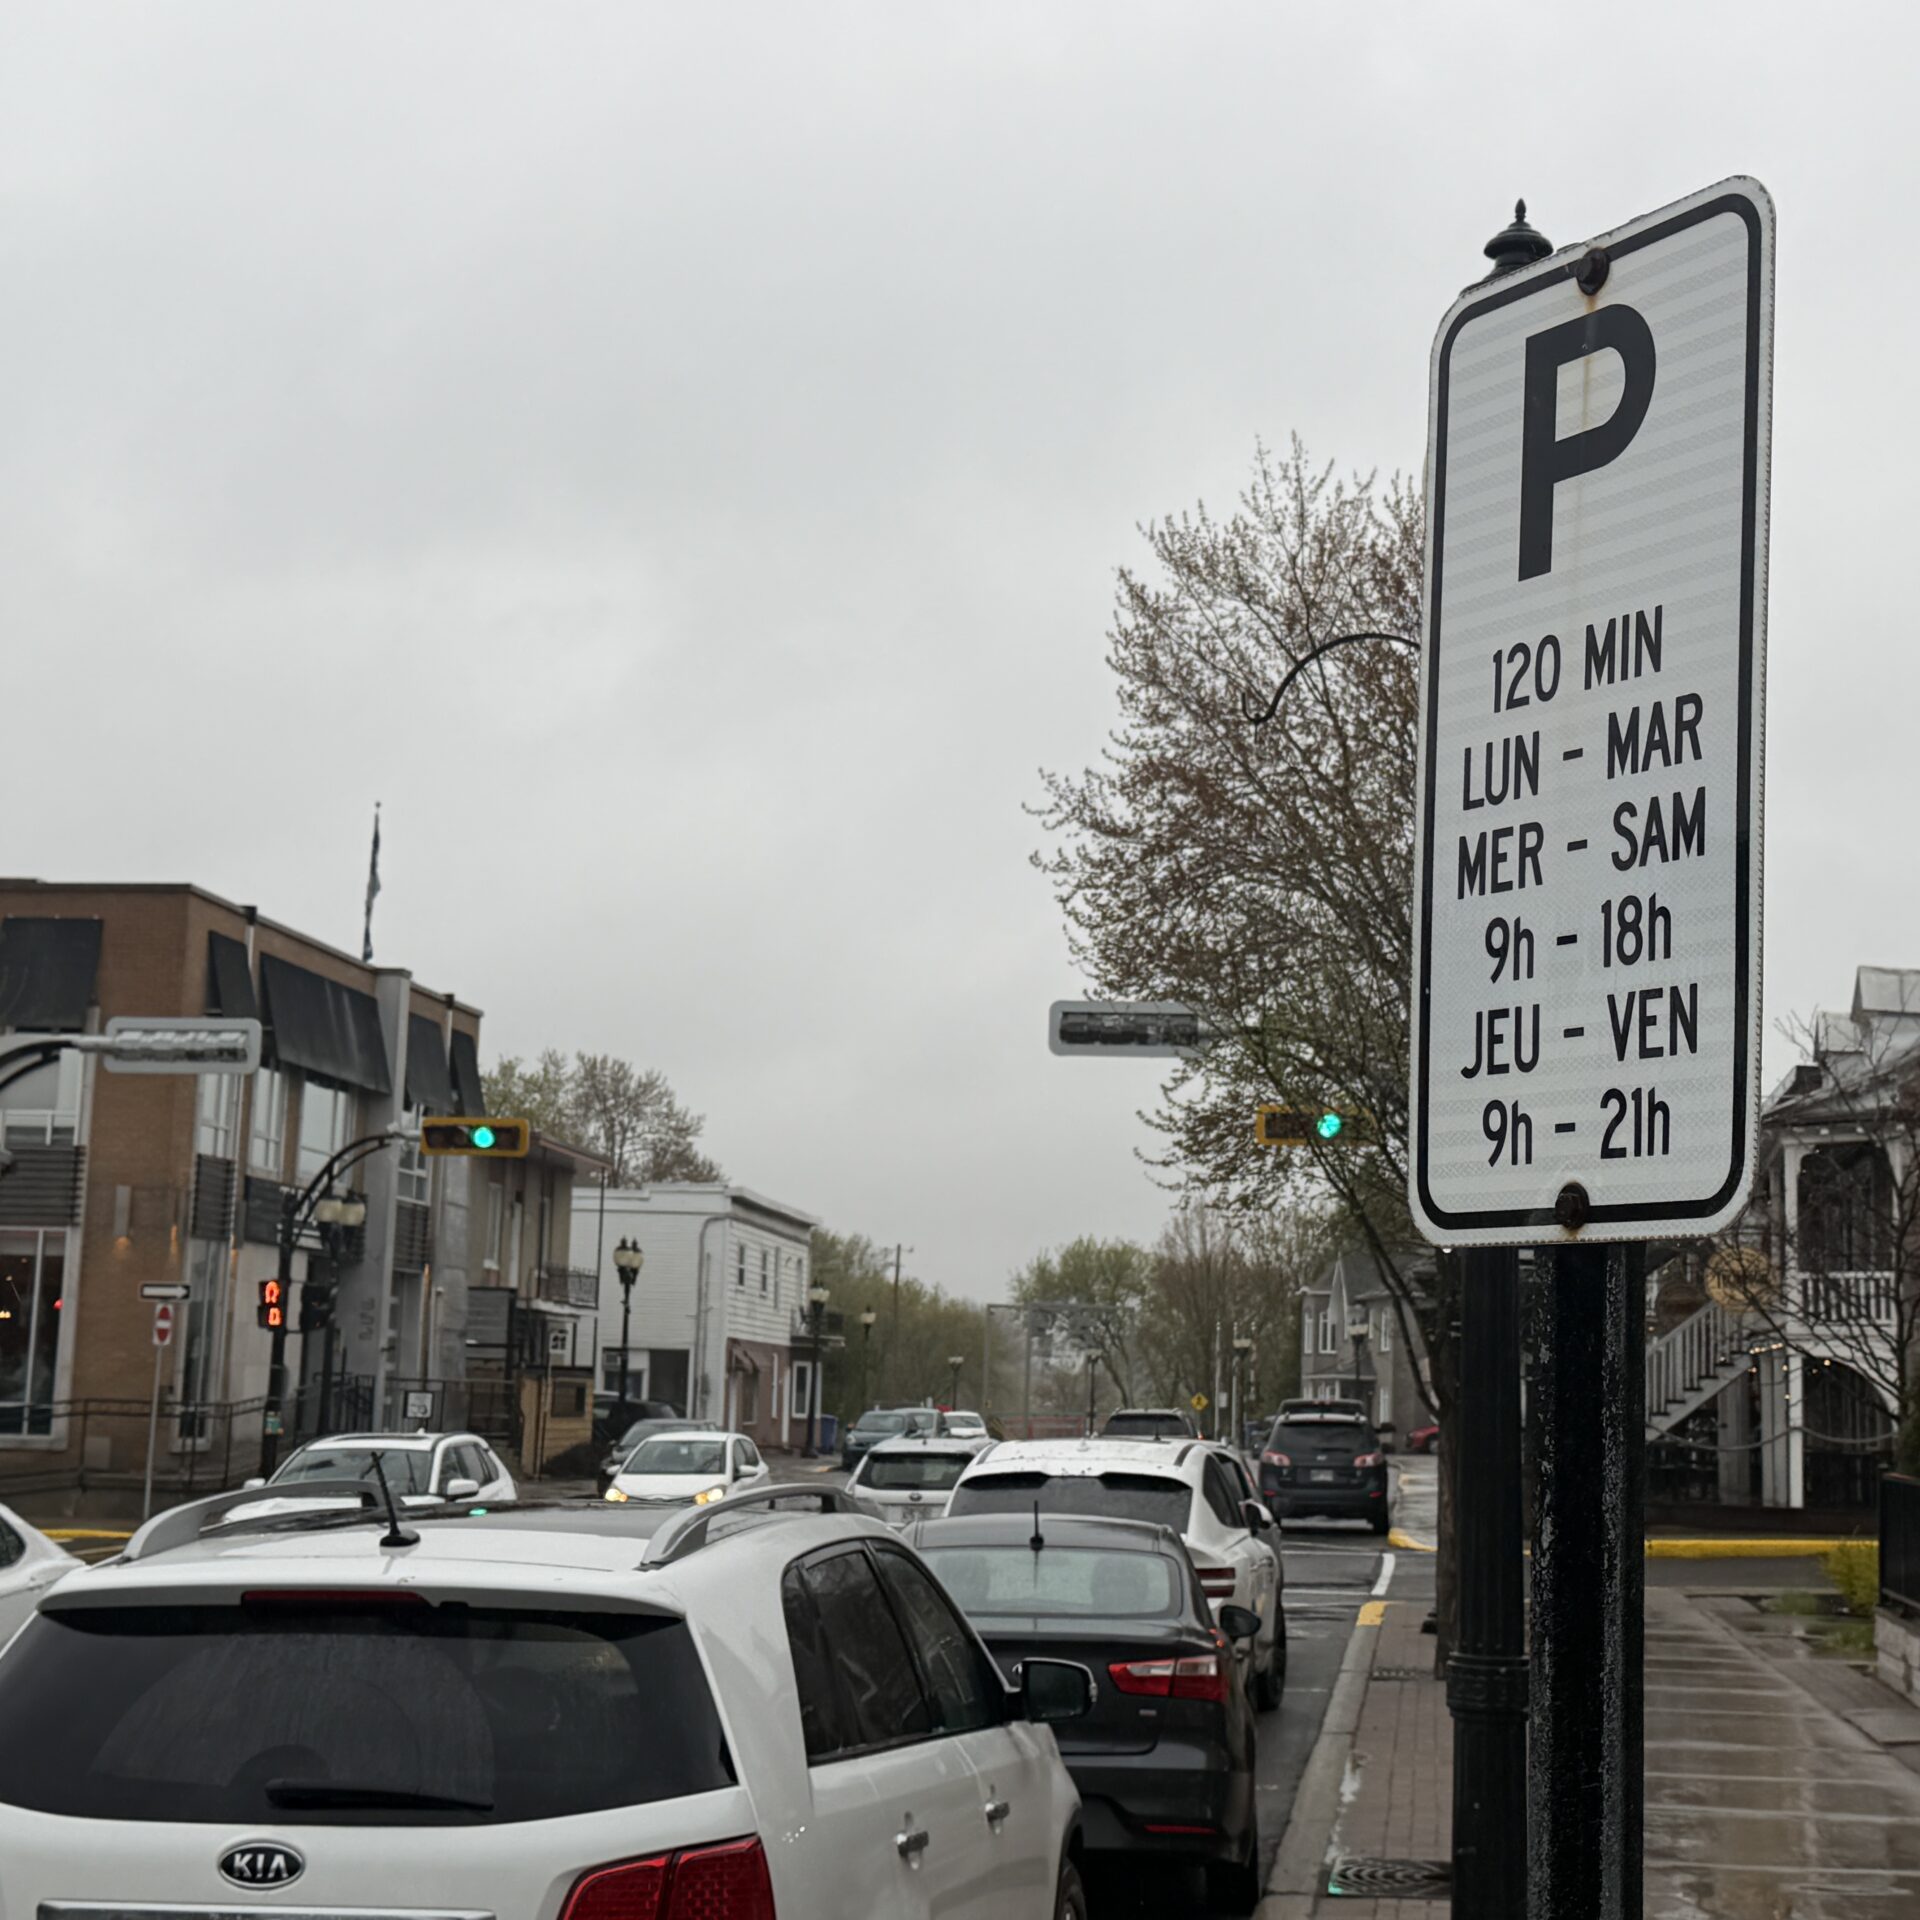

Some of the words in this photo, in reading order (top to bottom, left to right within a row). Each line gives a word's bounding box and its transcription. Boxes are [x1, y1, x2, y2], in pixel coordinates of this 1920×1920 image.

[1517, 303, 1657, 583] P
[1492, 634, 1561, 714] 120
[1584, 604, 1663, 691] MIN
[1462, 730, 1540, 812] LUN
[1562, 747, 1584, 762] -
[1607, 692, 1704, 780] MAR
[1457, 821, 1545, 901] MER
[1566, 838, 1588, 853] -
[1610, 785, 1706, 872] SAM
[1484, 915, 1535, 985] 9h
[1556, 933, 1578, 947] -
[1600, 892, 1672, 968] 18h
[1460, 1003, 1540, 1080] JEU
[1563, 1026, 1585, 1039] -
[1606, 982, 1698, 1062] VEN
[1482, 1099, 1533, 1168] 9h
[1554, 1121, 1576, 1134] -
[1599, 1086, 1671, 1160] 21h
[233, 1852, 289, 1879] KIA
